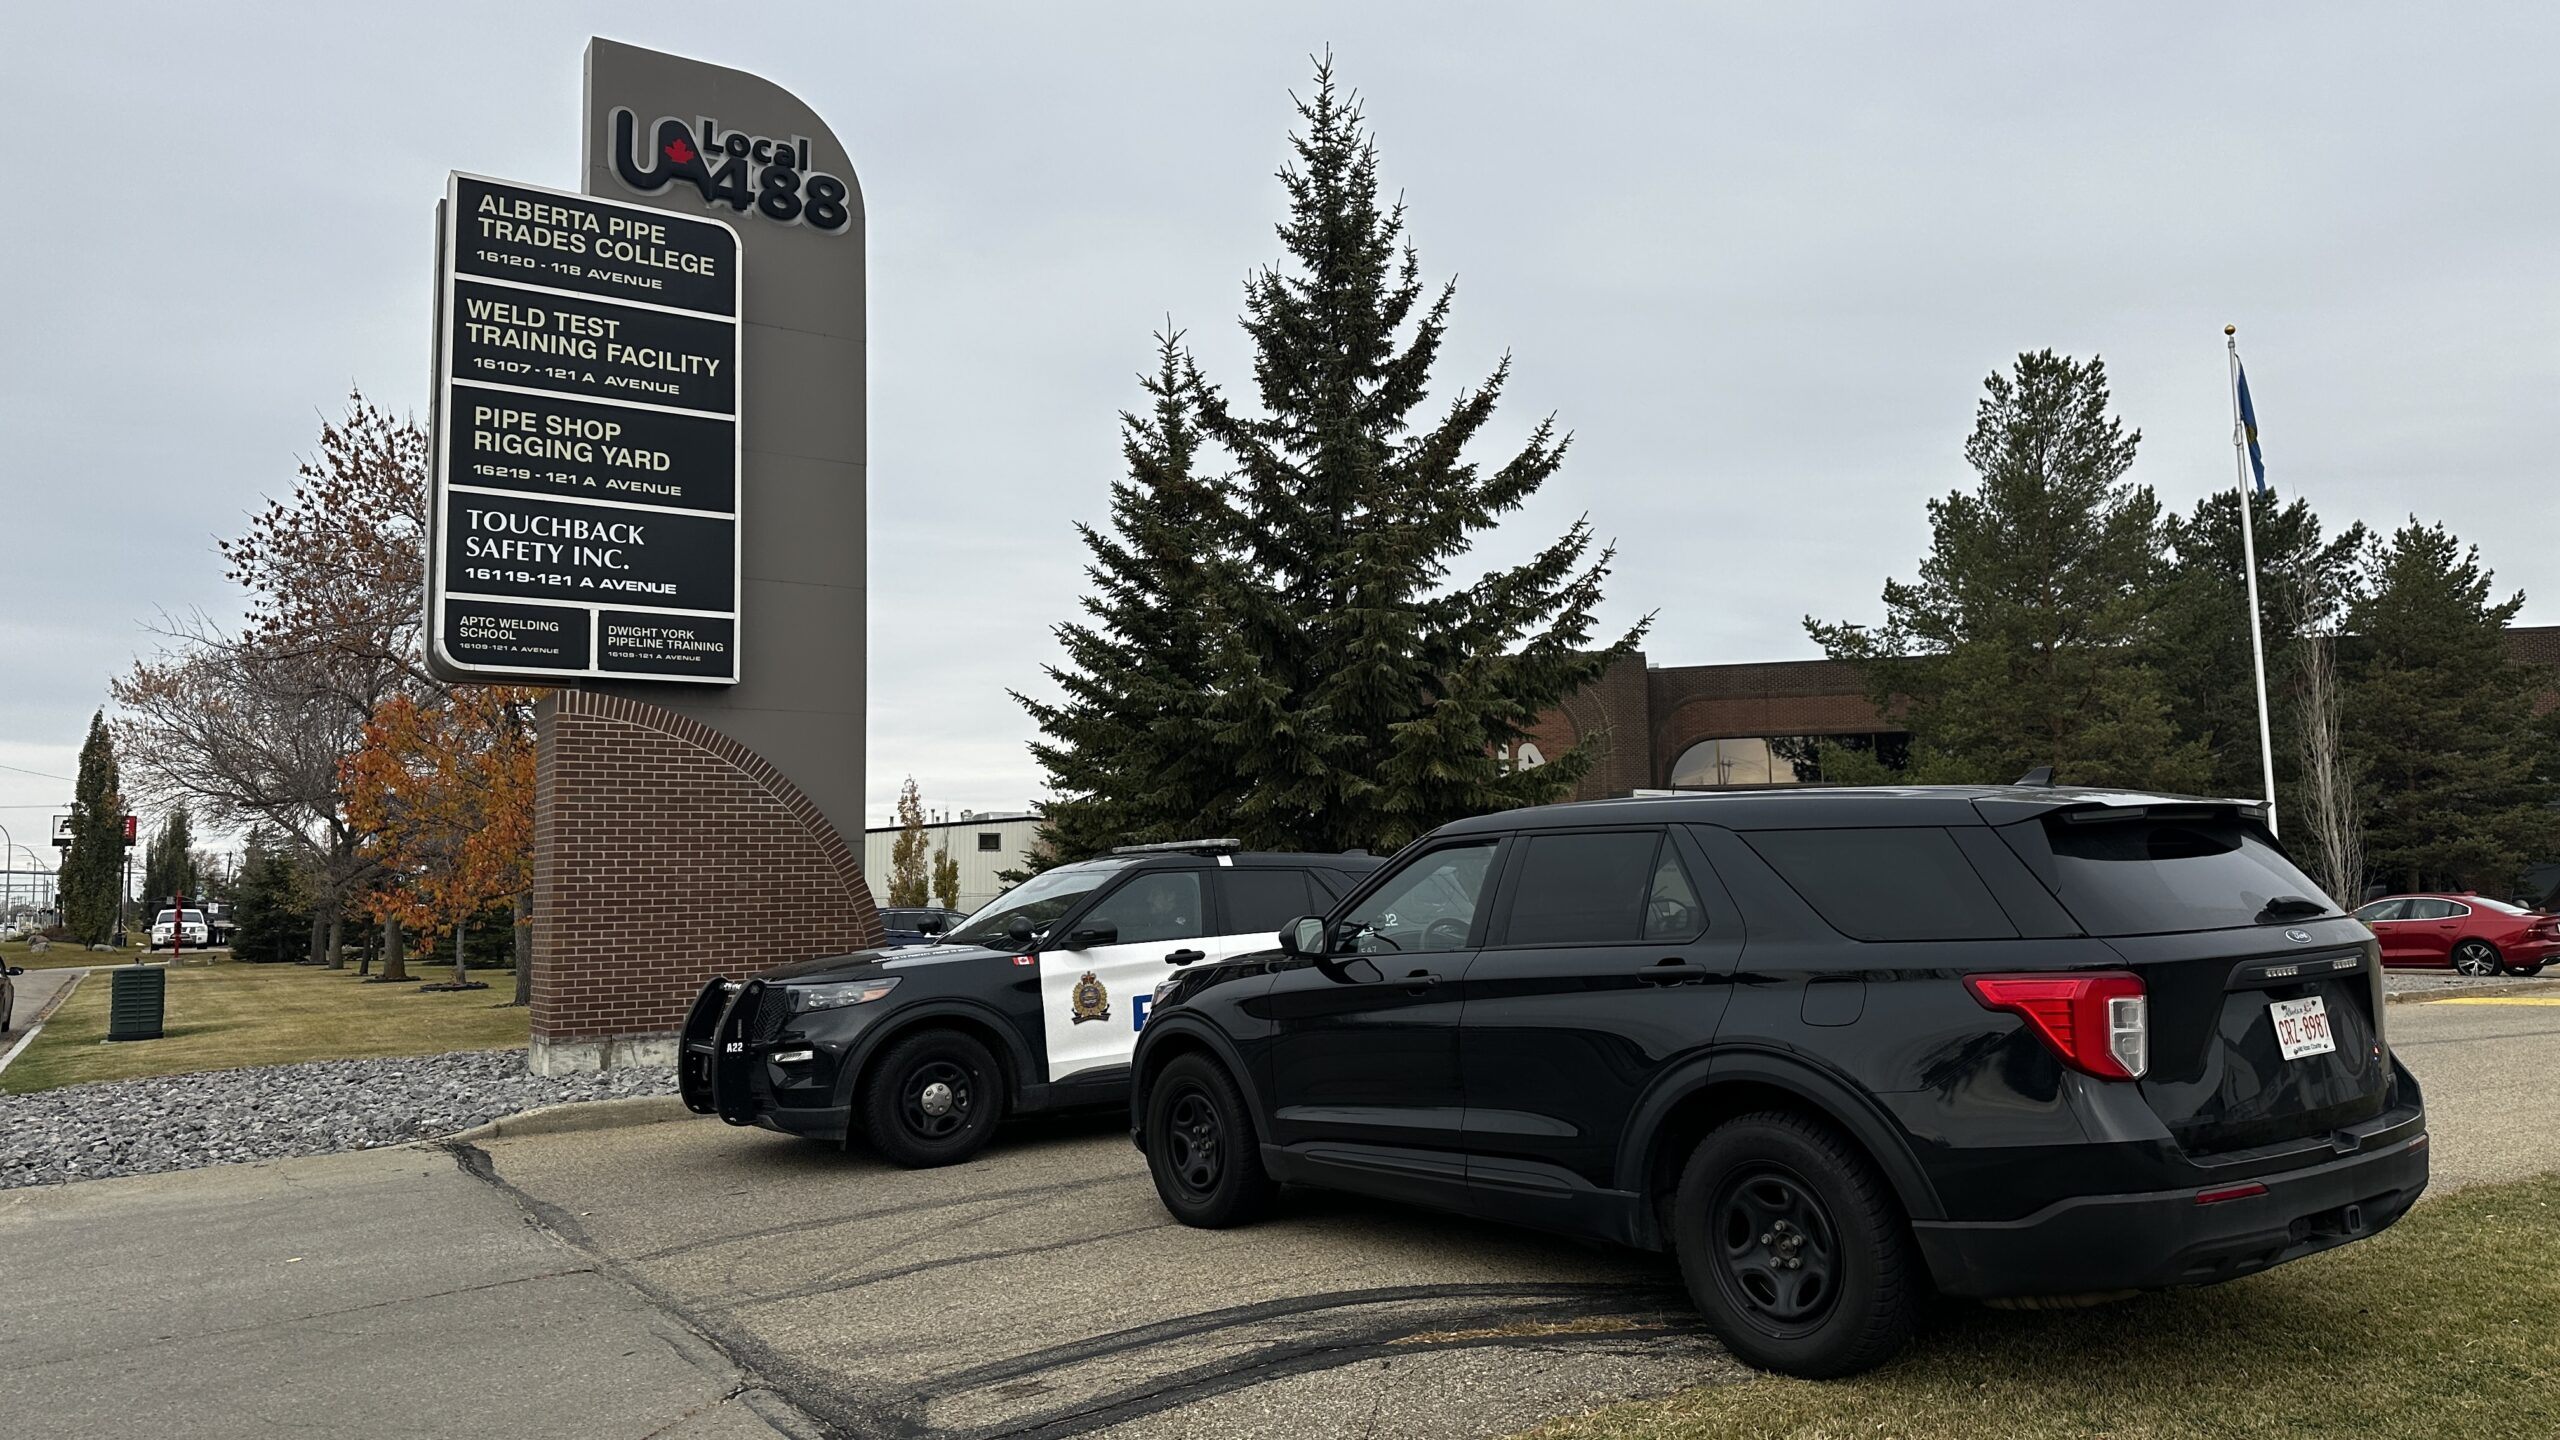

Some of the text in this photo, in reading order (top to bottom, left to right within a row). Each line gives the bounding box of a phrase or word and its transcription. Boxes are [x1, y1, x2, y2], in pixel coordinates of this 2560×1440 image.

[703, 120, 808, 171] Local
[616, 109, 848, 230] UA 488
[478, 194, 666, 245] ALBERTA PIPE
[477, 217, 715, 277] TRADES COLLEGE
[476, 250, 535, 268] 16120
[551, 263, 581, 276] 118
[587, 269, 662, 289] AVENUE
[466, 298, 619, 339] WELD TEST
[466, 322, 720, 377] TRAINING FACILITY
[582, 373, 595, 383] A
[604, 377, 679, 394] AVENUE
[475, 406, 621, 442] PIPE SHOP
[474, 431, 670, 472] RIGGING YARD
[473, 465, 530, 479] 16219
[546, 472, 576, 485] 121
[583, 477, 596, 486] A
[606, 480, 682, 496] AVENUE
[466, 510, 645, 545] TOUCHBACK
[466, 537, 630, 570] SAFETY INC.
[580, 577, 594, 587] A
[599, 579, 677, 595] AVENUE
[460, 616, 559, 632] APTC WELDING
[460, 627, 516, 640] SCHOOL
[608, 626, 694, 639] DWIGHT YORK
[608, 637, 724, 652] PIPELINE TRAINING
[726, 1042, 743, 1053] A22
